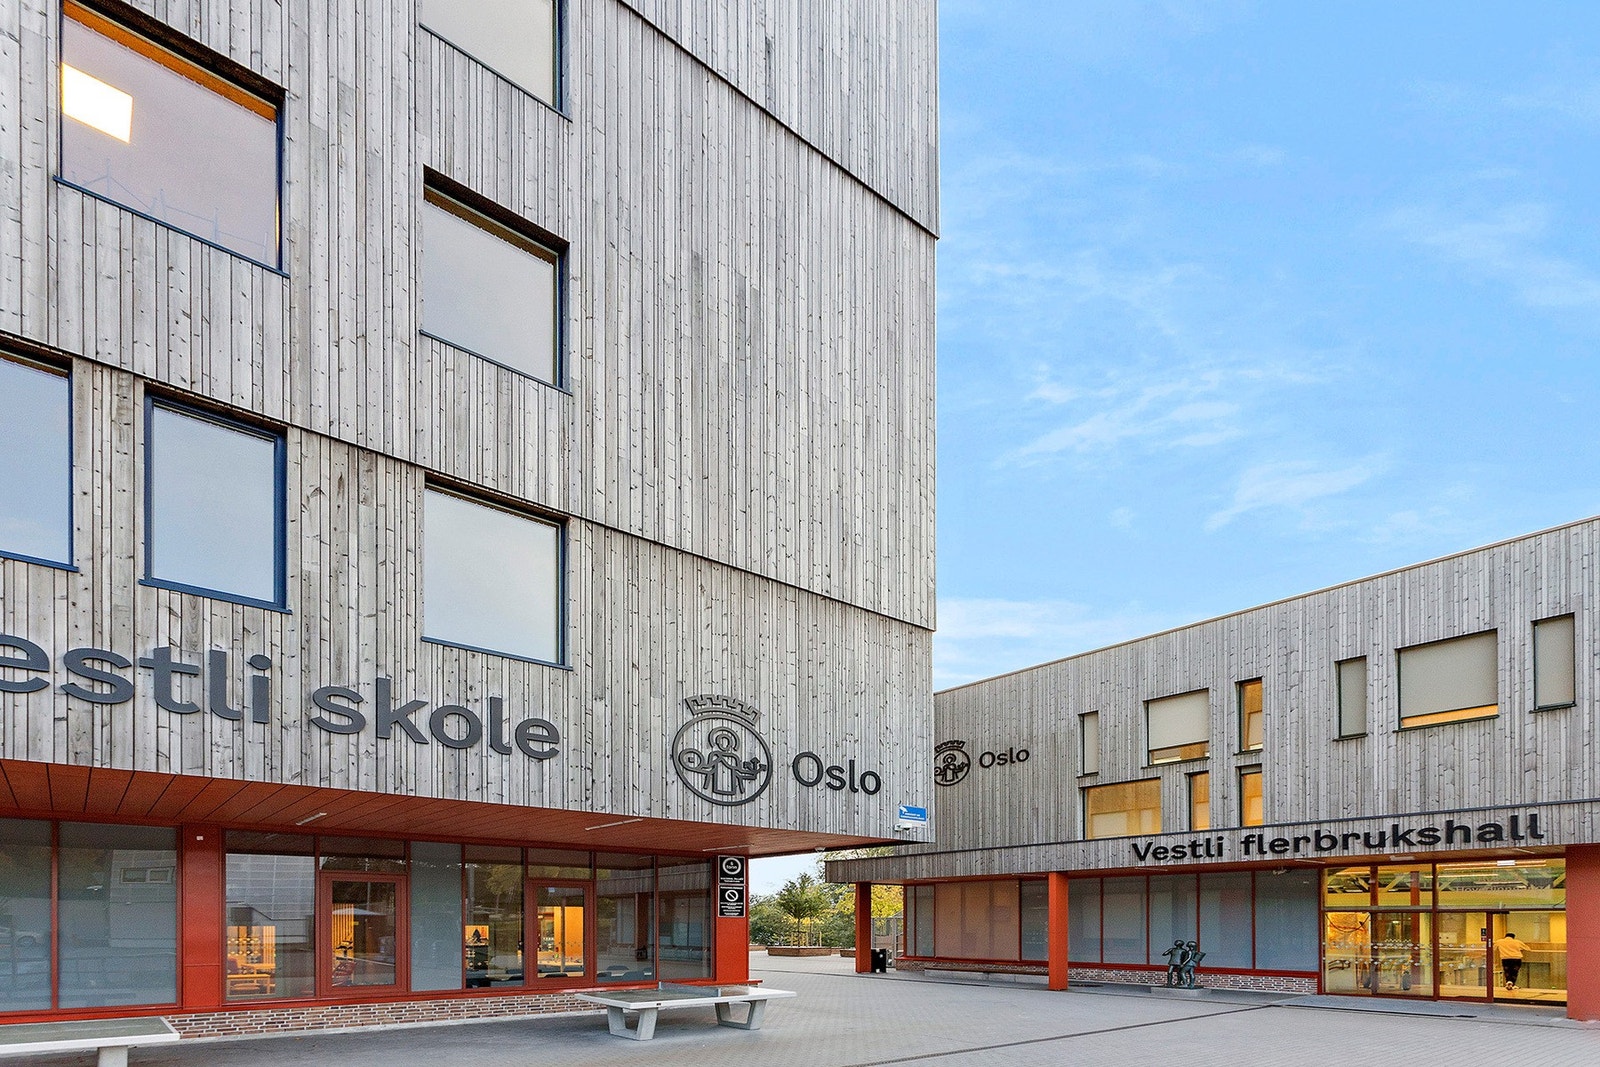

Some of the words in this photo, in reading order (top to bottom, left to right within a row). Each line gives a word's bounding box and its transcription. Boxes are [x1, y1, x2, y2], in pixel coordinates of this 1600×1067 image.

[311, 675, 560, 760] skole
[793, 751, 882, 795] Oslo
[979, 747, 1030, 769] Oslo
[1131, 837, 1225, 862] Vestli
[1240, 813, 1544, 854] flerbrukshall
